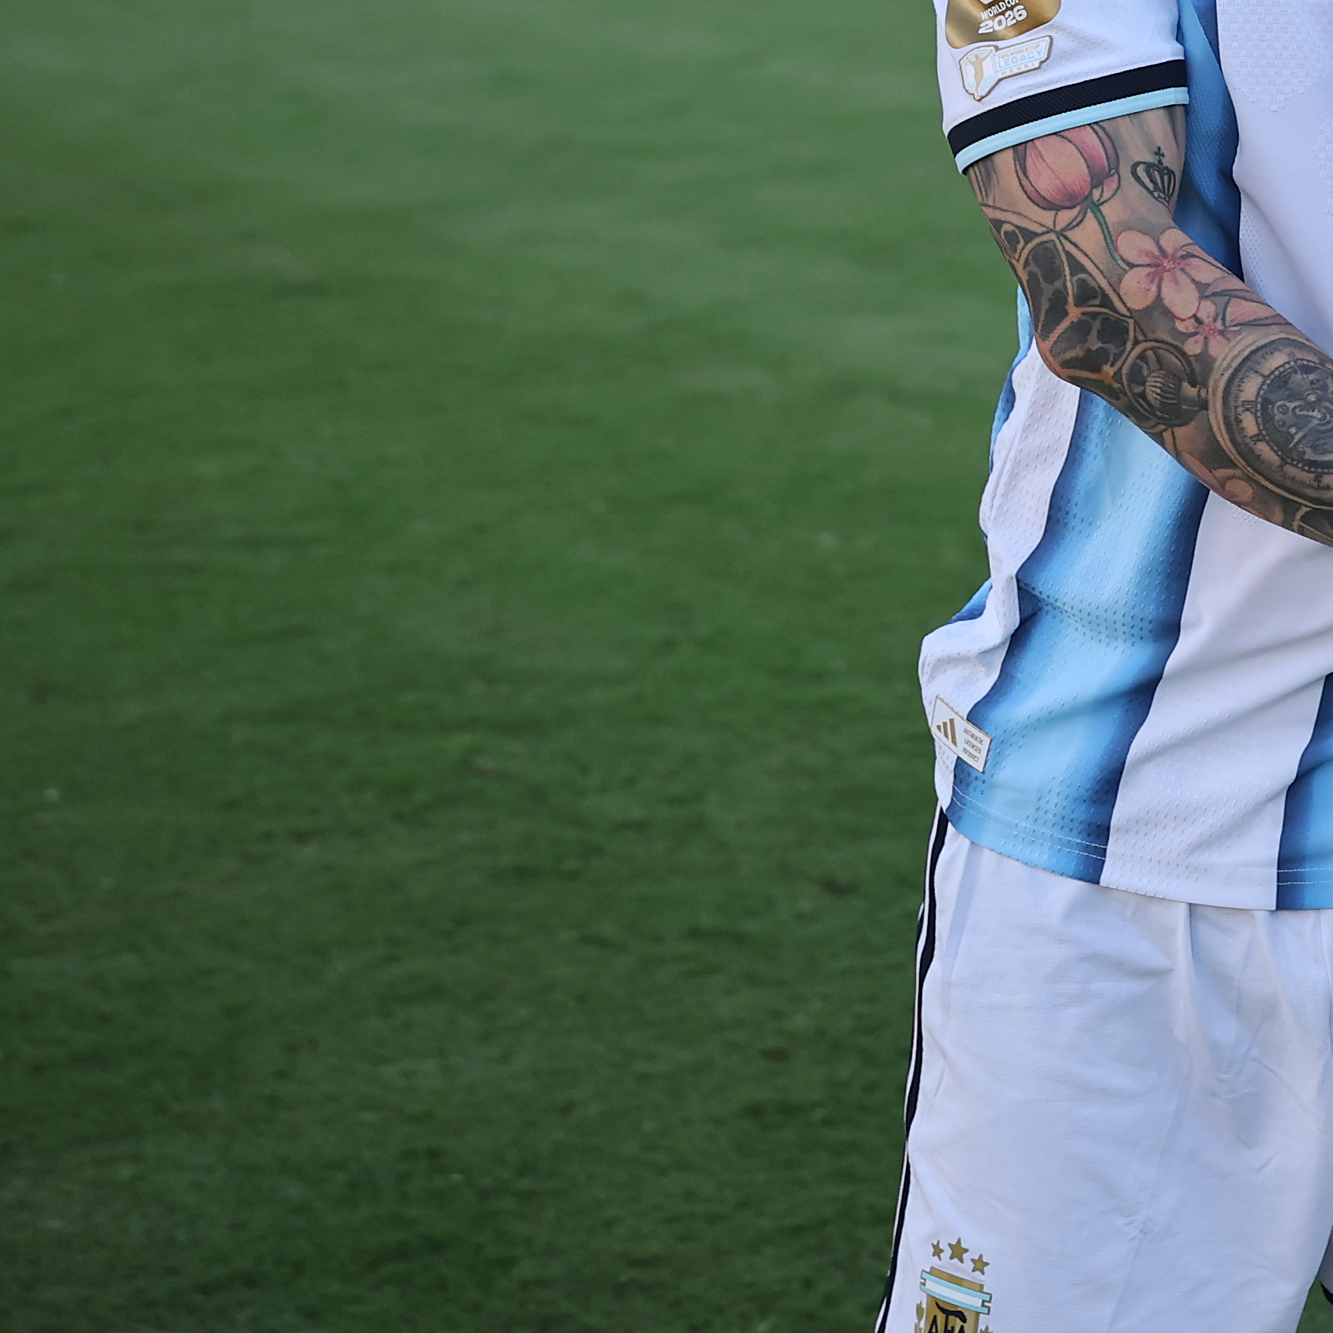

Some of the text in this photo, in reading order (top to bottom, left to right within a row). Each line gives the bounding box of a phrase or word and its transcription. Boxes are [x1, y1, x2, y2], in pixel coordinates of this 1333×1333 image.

[978, 5, 1028, 34] 2026
[980, 1, 1006, 20] WORLD
[997, 48, 1043, 68] LEGACY
[927, 1300, 967, 1333] AF
